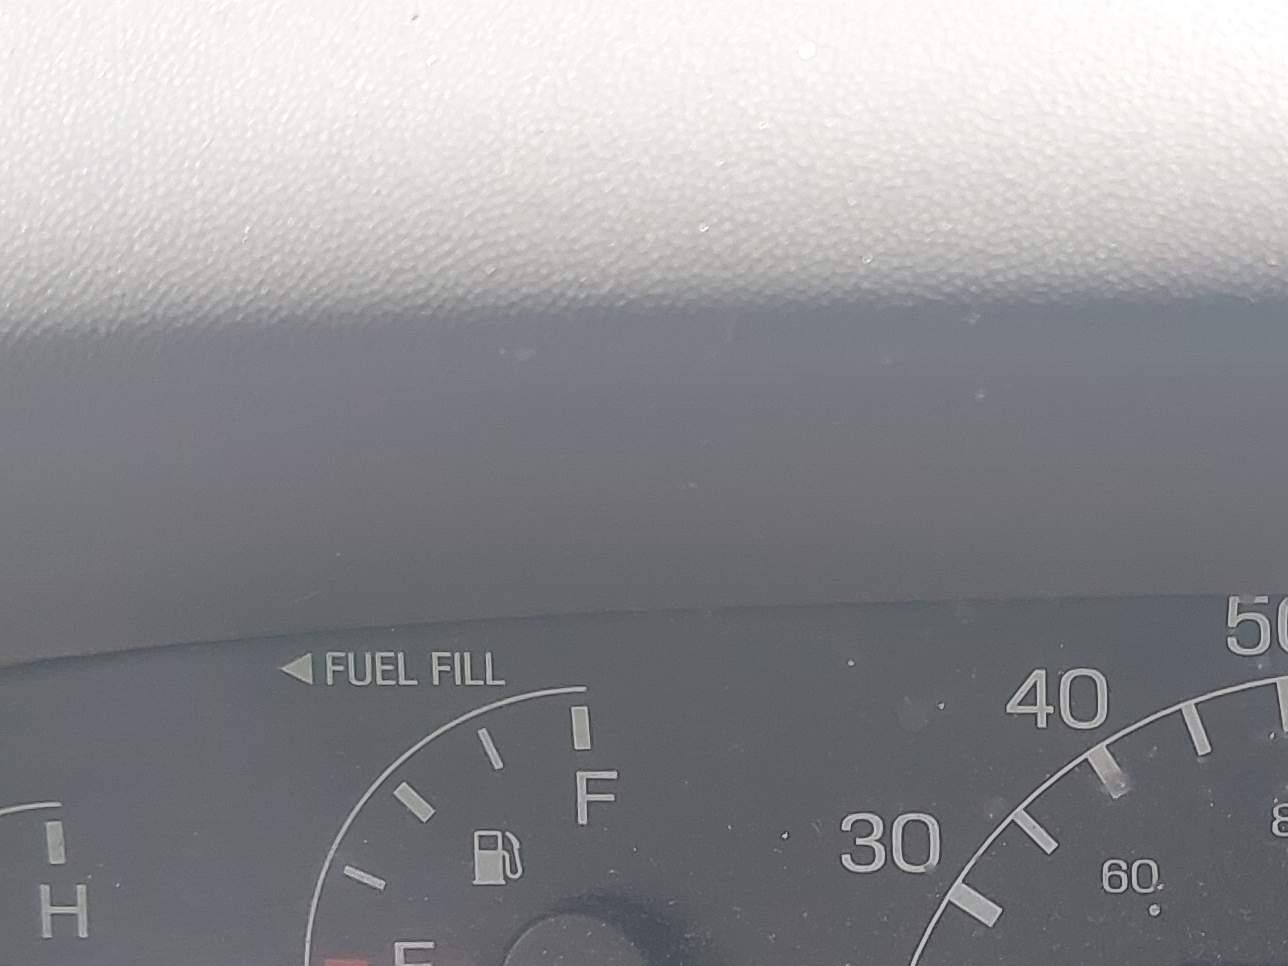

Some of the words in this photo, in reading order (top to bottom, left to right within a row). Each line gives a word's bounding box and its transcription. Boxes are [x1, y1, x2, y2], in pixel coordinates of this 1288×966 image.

[325, 652, 417, 687] FUEL
[432, 652, 506, 686] FILL
[1005, 668, 1110, 729] 40
[576, 771, 618, 825] F
[839, 813, 942, 873] 30
[1101, 859, 1160, 894] 60
[40, 884, 88, 939] H
